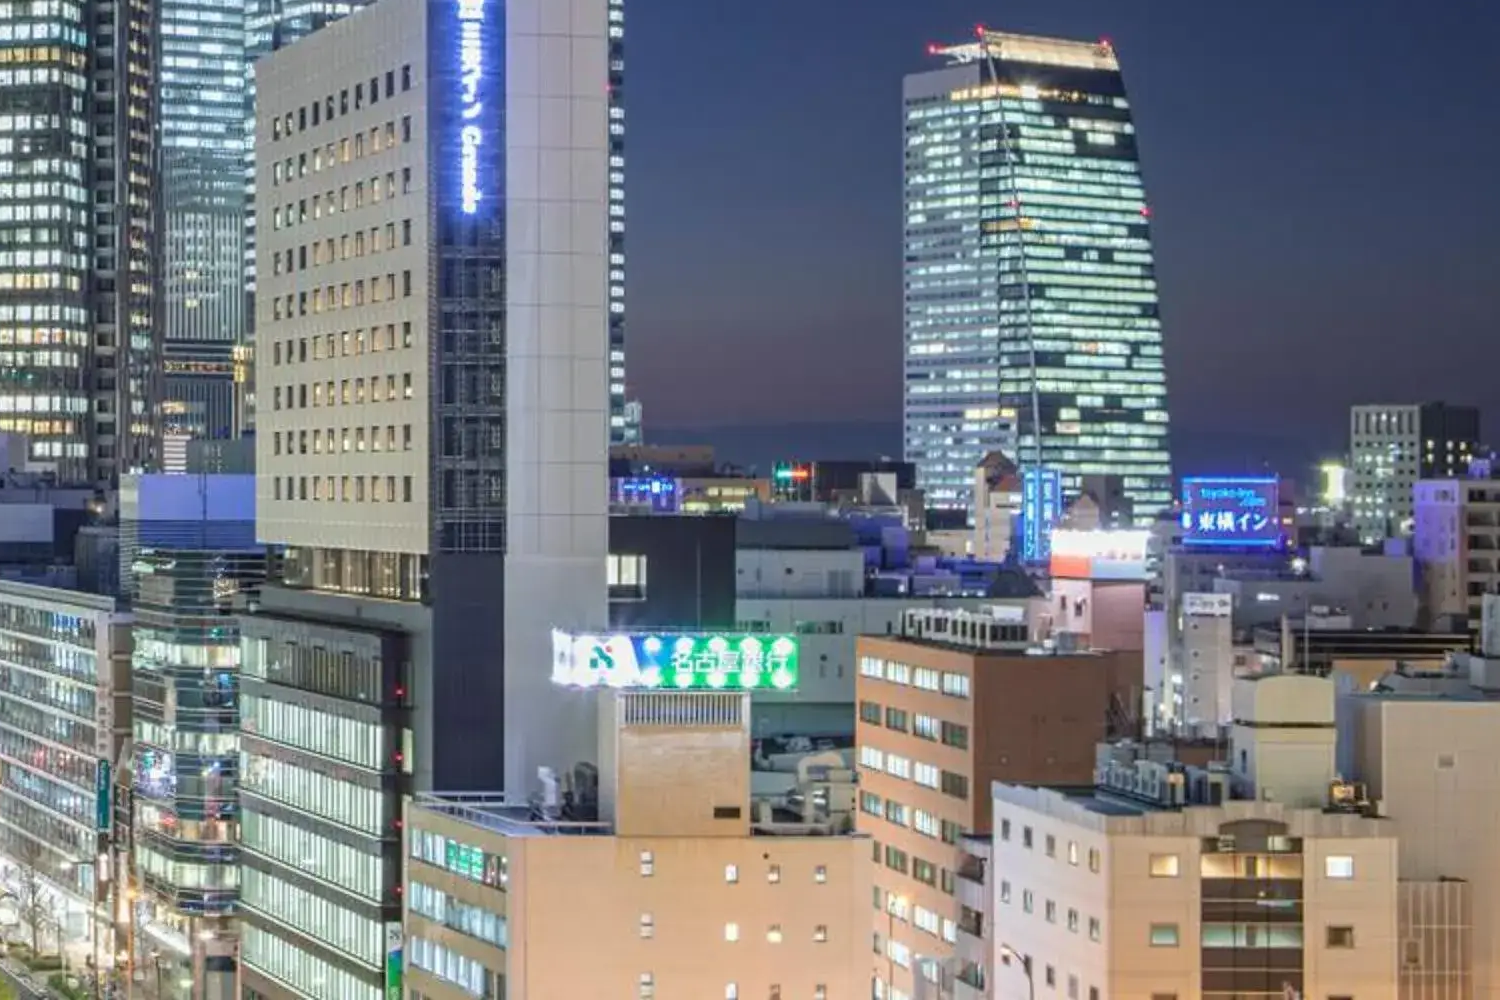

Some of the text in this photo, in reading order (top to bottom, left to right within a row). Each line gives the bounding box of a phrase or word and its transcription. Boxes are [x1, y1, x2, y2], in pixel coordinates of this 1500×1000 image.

[1198, 511, 1269, 532] 東横イン
[669, 649, 789, 674] 名古屋銀行
